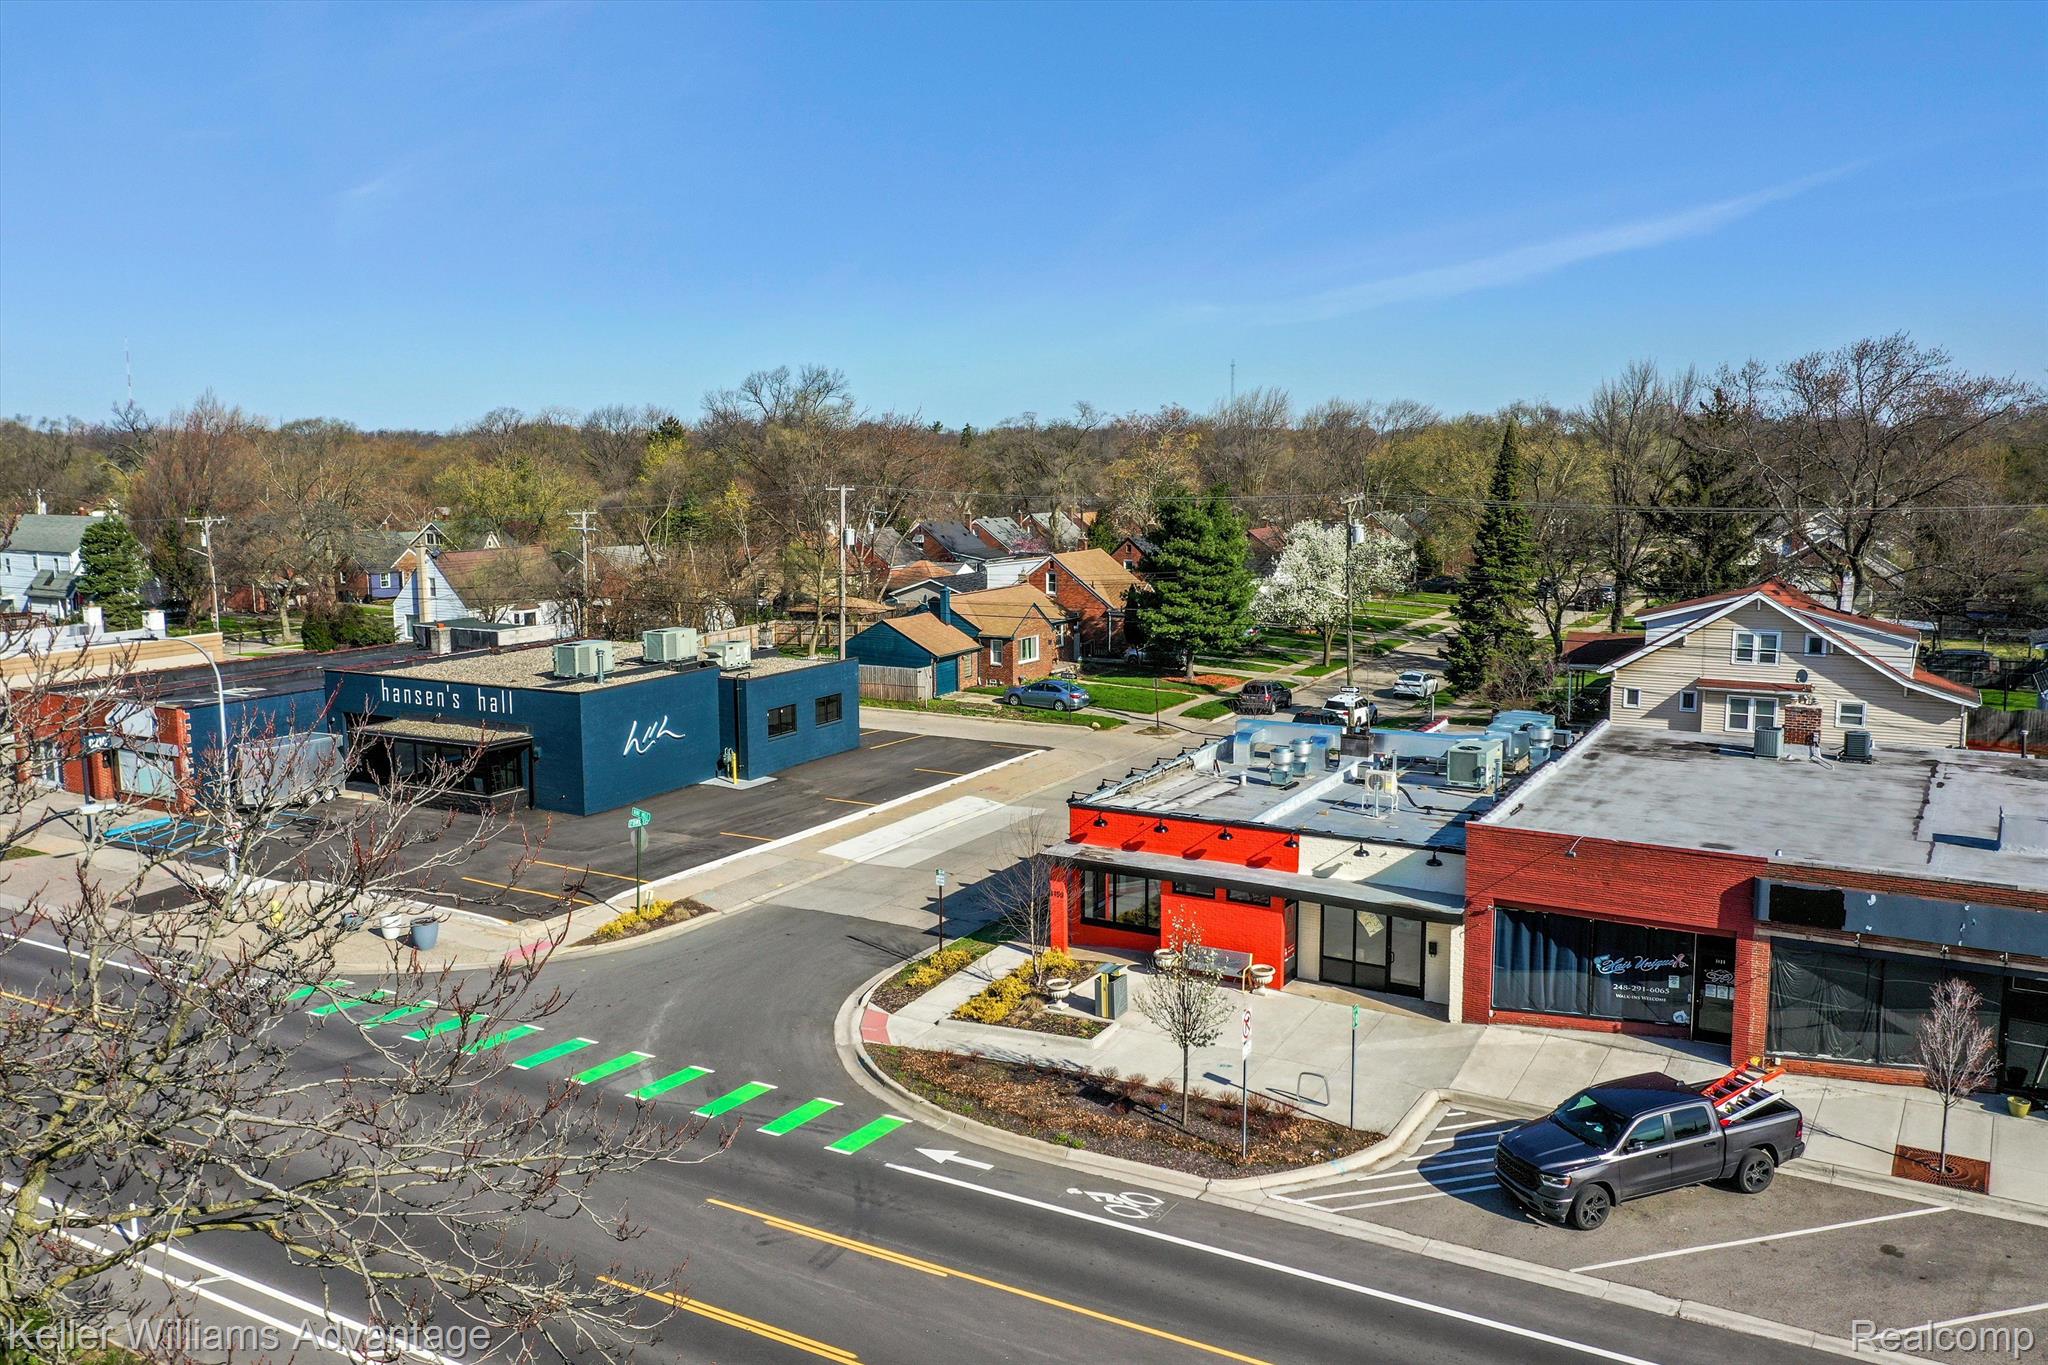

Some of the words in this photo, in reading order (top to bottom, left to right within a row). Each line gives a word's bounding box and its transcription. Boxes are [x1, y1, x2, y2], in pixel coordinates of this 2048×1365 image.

[381, 678, 460, 709] hansen's
[477, 687, 513, 715] hall
[1601, 957, 1633, 974] Hair
[1634, 955, 1675, 972] Unique
[1612, 983, 1670, 995] 248-291-6065
